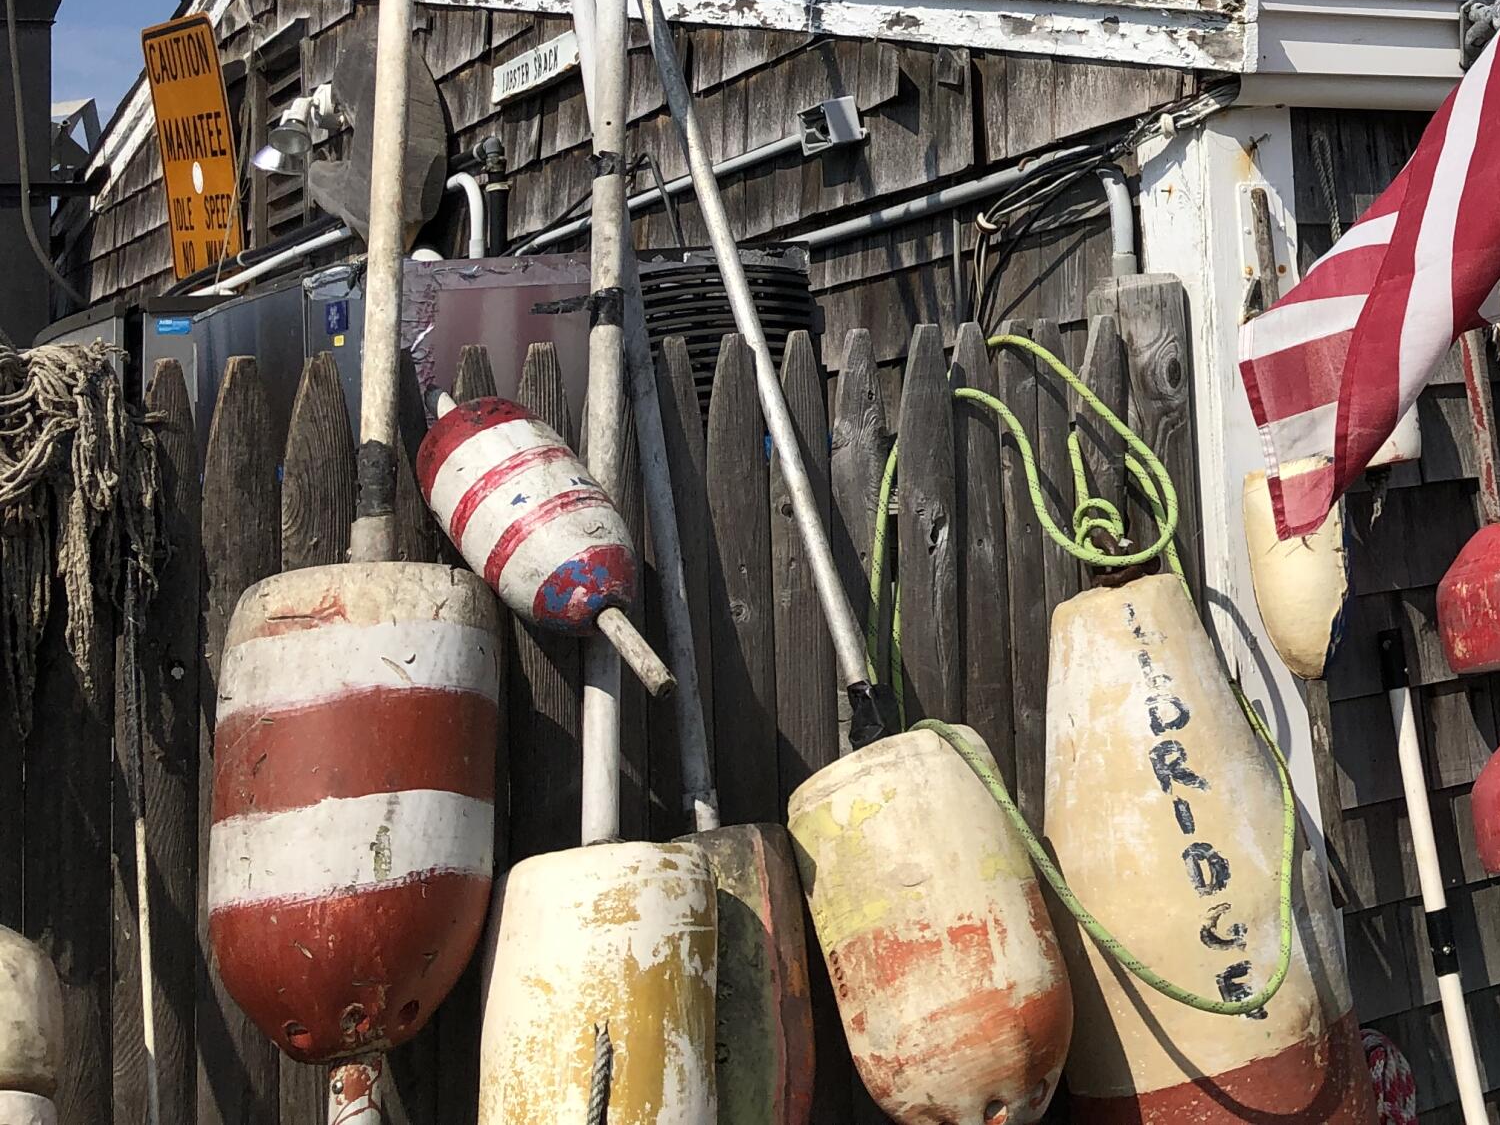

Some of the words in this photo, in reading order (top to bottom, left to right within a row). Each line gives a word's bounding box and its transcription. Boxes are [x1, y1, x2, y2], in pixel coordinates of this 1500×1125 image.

[148, 30, 211, 85] CAUTION
[502, 61, 530, 94] LOBSTER
[162, 111, 227, 163] MANATEE
[173, 196, 195, 231] IDLE
[182, 239, 196, 274] NO
